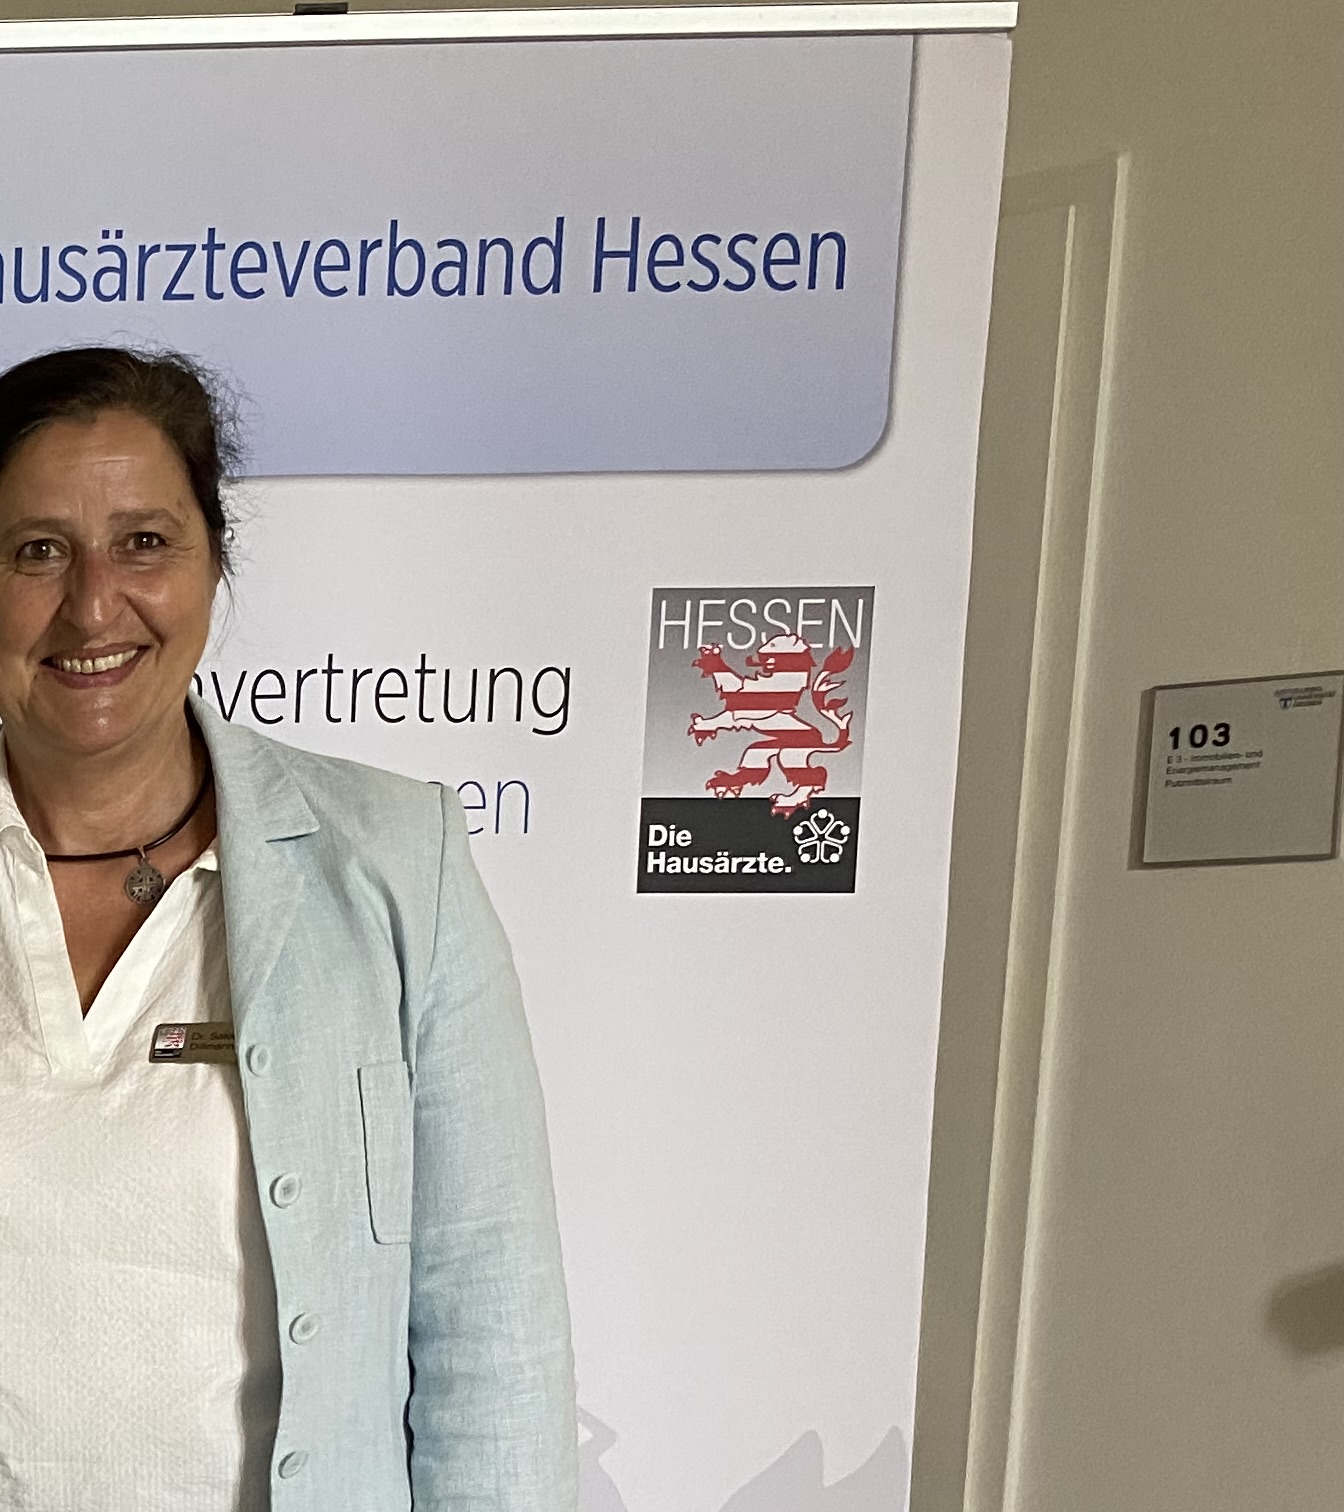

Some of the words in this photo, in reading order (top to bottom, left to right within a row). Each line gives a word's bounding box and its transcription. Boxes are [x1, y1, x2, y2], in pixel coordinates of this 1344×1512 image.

[591, 213, 849, 295] Hessen
[657, 598, 864, 650] HESSEN
[192, 653, 572, 736] vertretung
[1168, 722, 1231, 750] 103
[647, 823, 692, 848] Die
[646, 850, 793, 874] Hausärzte.
